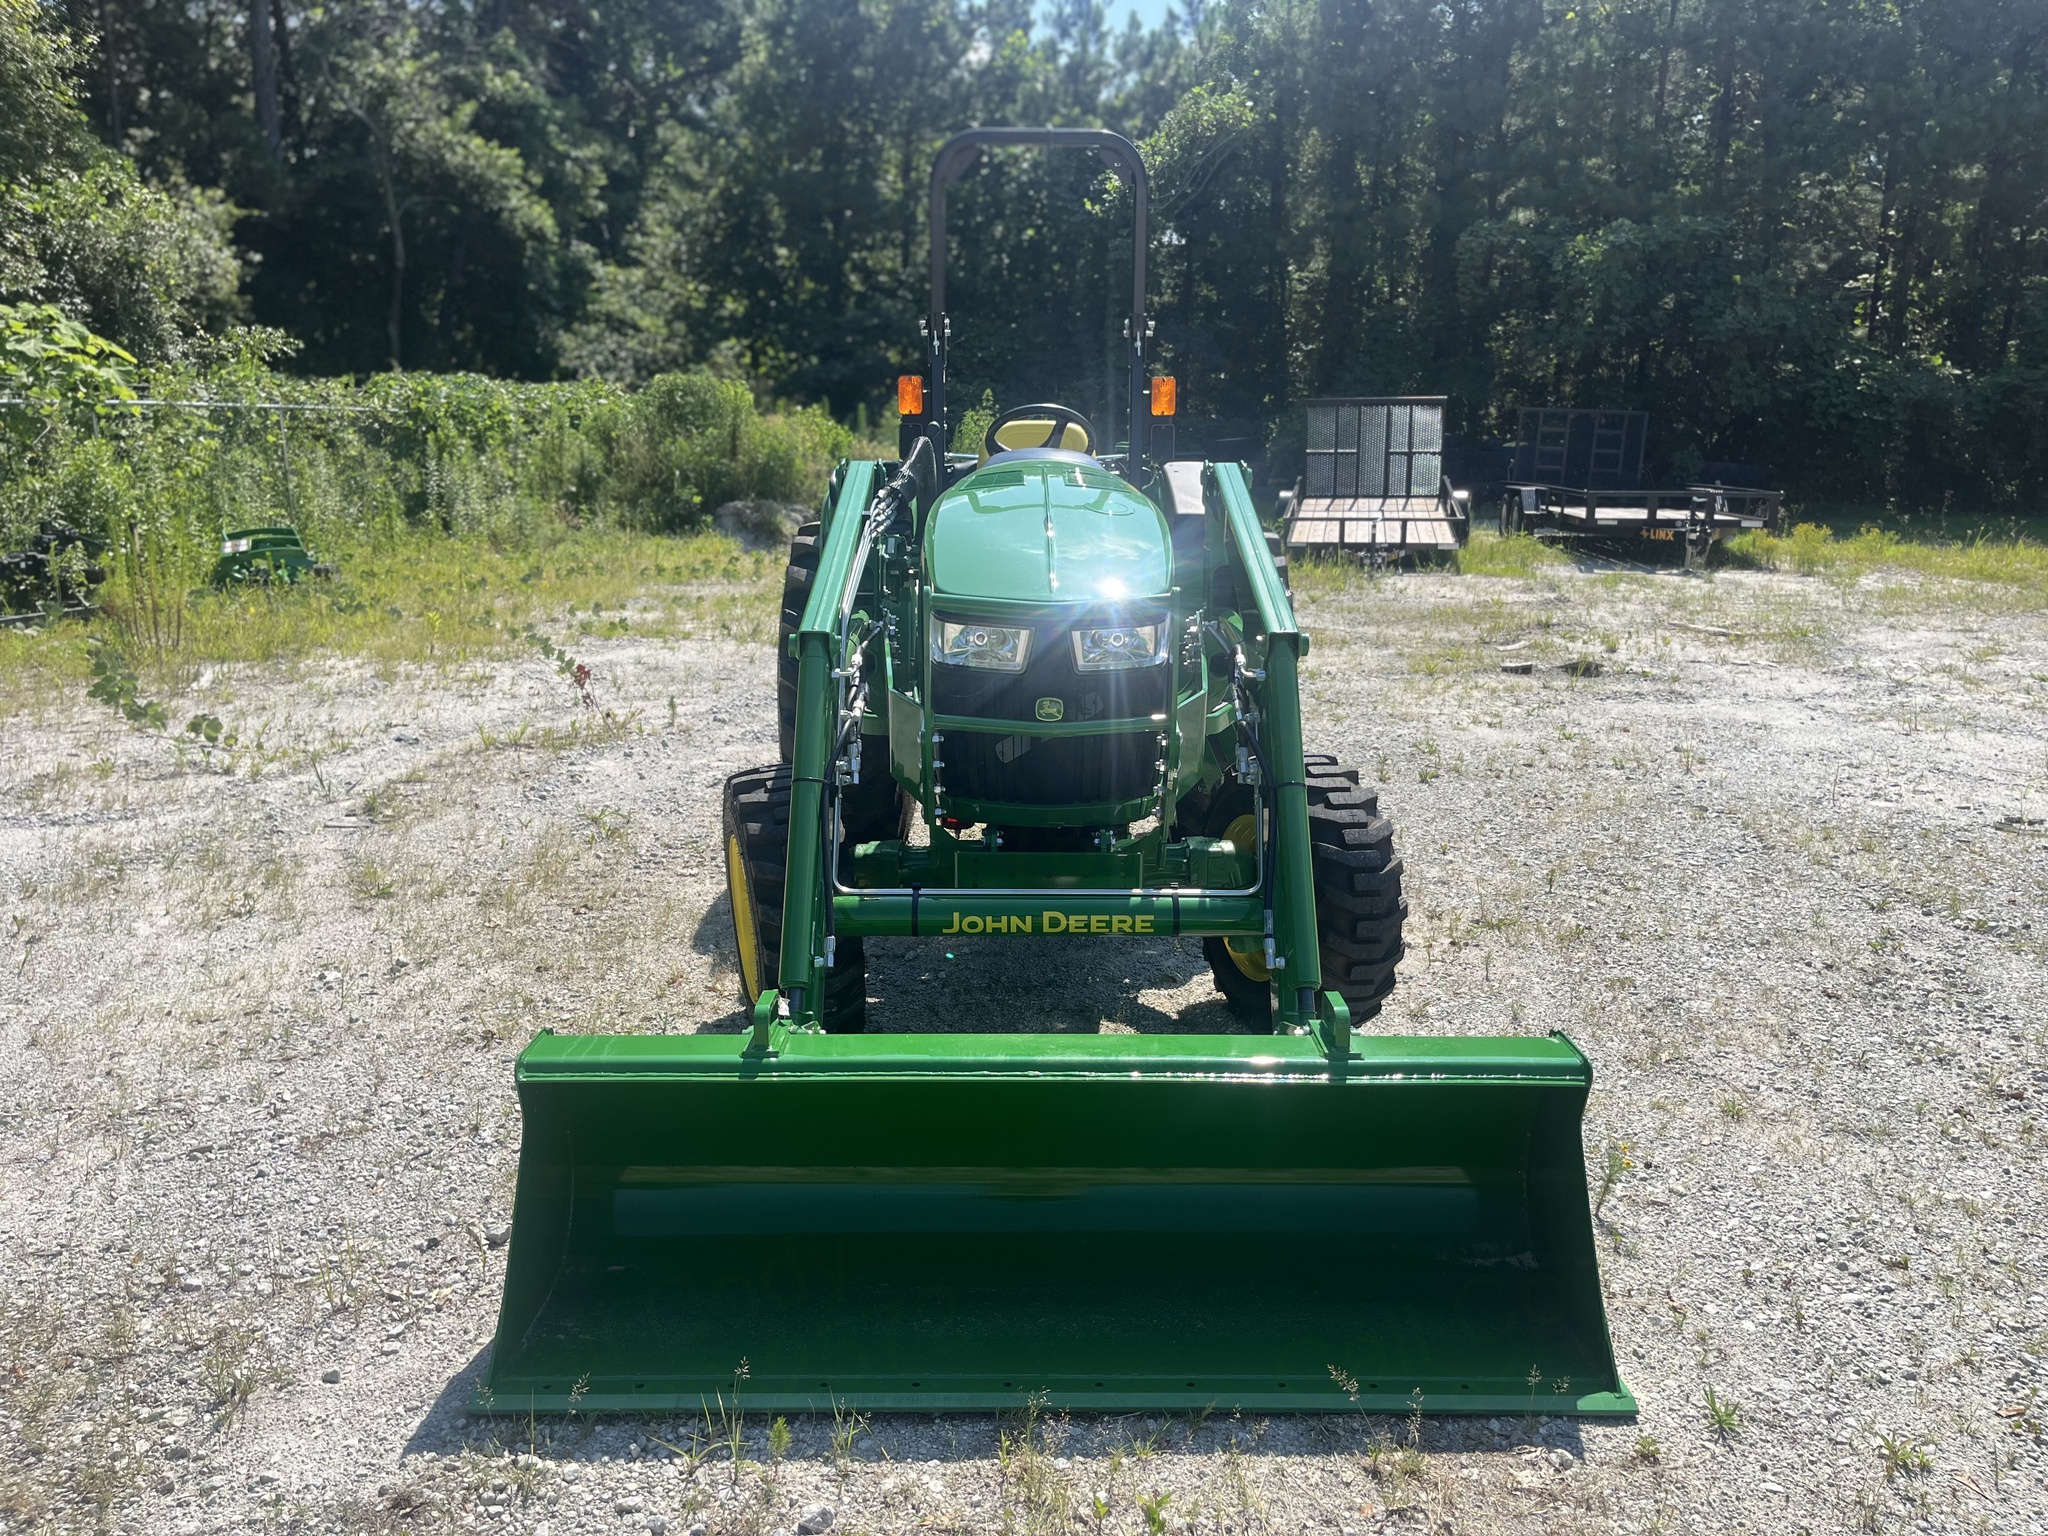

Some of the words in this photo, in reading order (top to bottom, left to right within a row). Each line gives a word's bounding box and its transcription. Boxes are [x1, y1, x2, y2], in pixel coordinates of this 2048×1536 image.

[1650, 528, 1675, 540] LINX
[942, 911, 1032, 933] JOHN
[1043, 911, 1155, 933] DEERE
